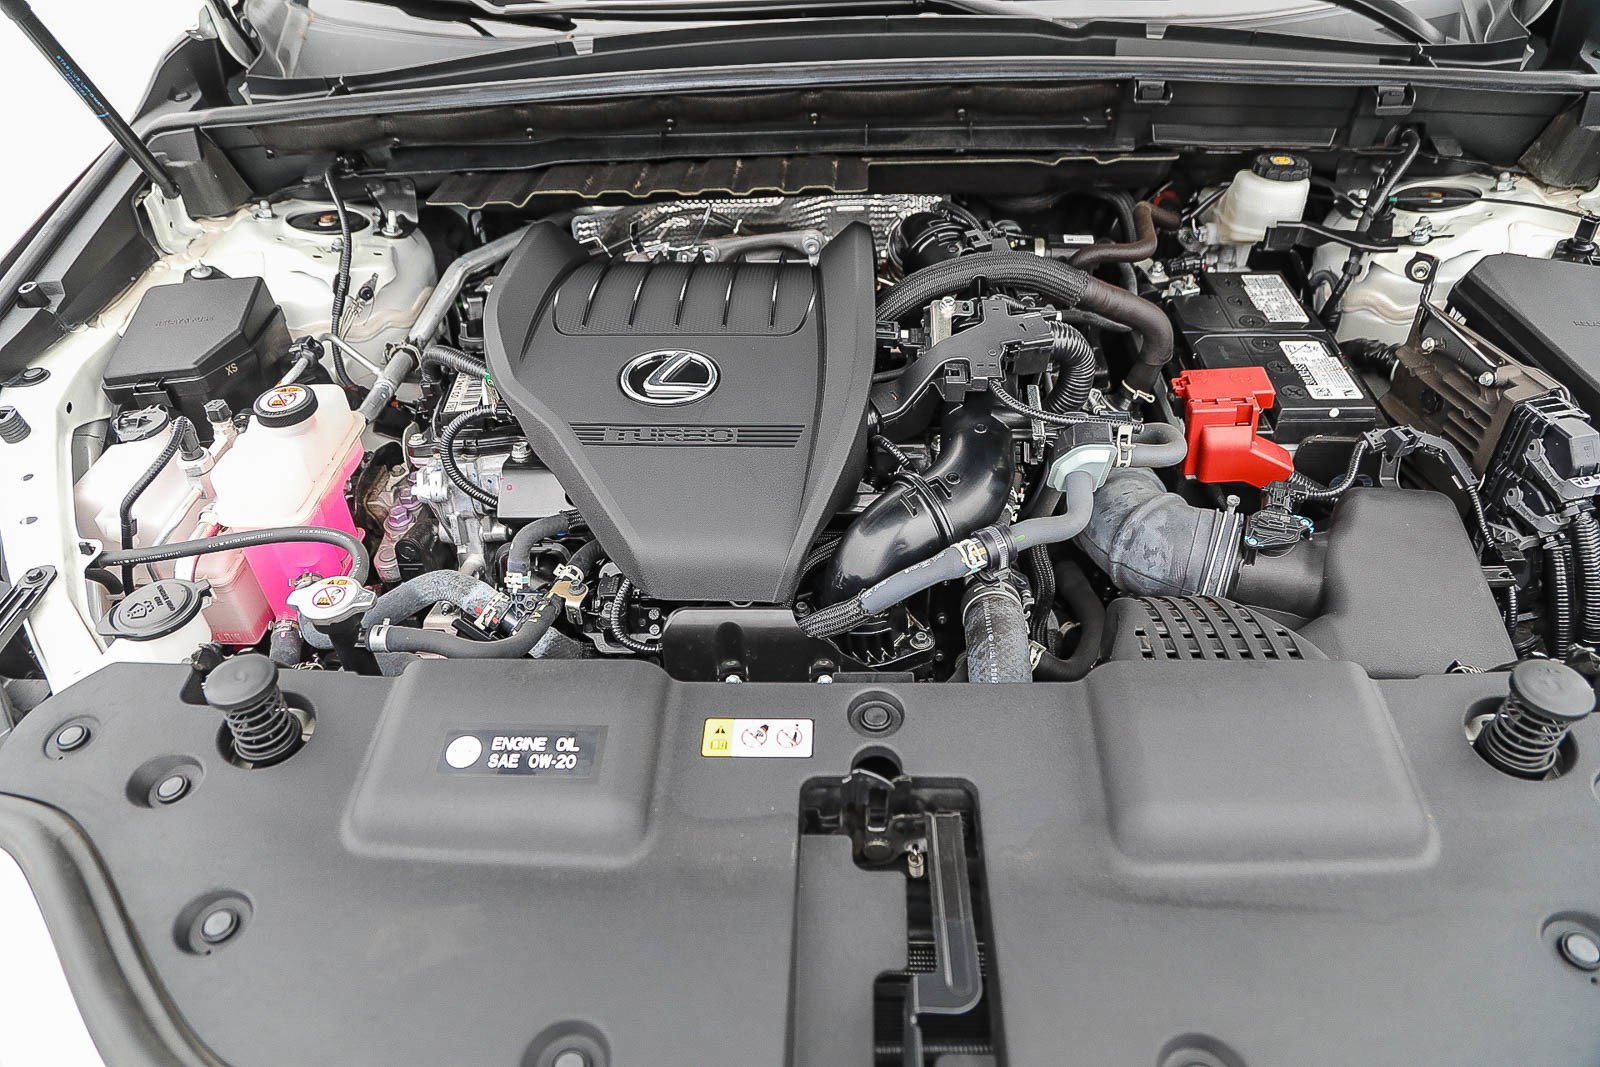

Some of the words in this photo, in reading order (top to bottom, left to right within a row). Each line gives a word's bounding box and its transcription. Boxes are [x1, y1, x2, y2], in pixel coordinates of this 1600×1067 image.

[224, 362, 238, 376] XS
[603, 426, 737, 442] TURBO
[491, 736, 548, 752] ENGINE
[556, 737, 580, 752] OIL
[488, 753, 520, 768] SAE
[528, 754, 578, 769] 0W-20
